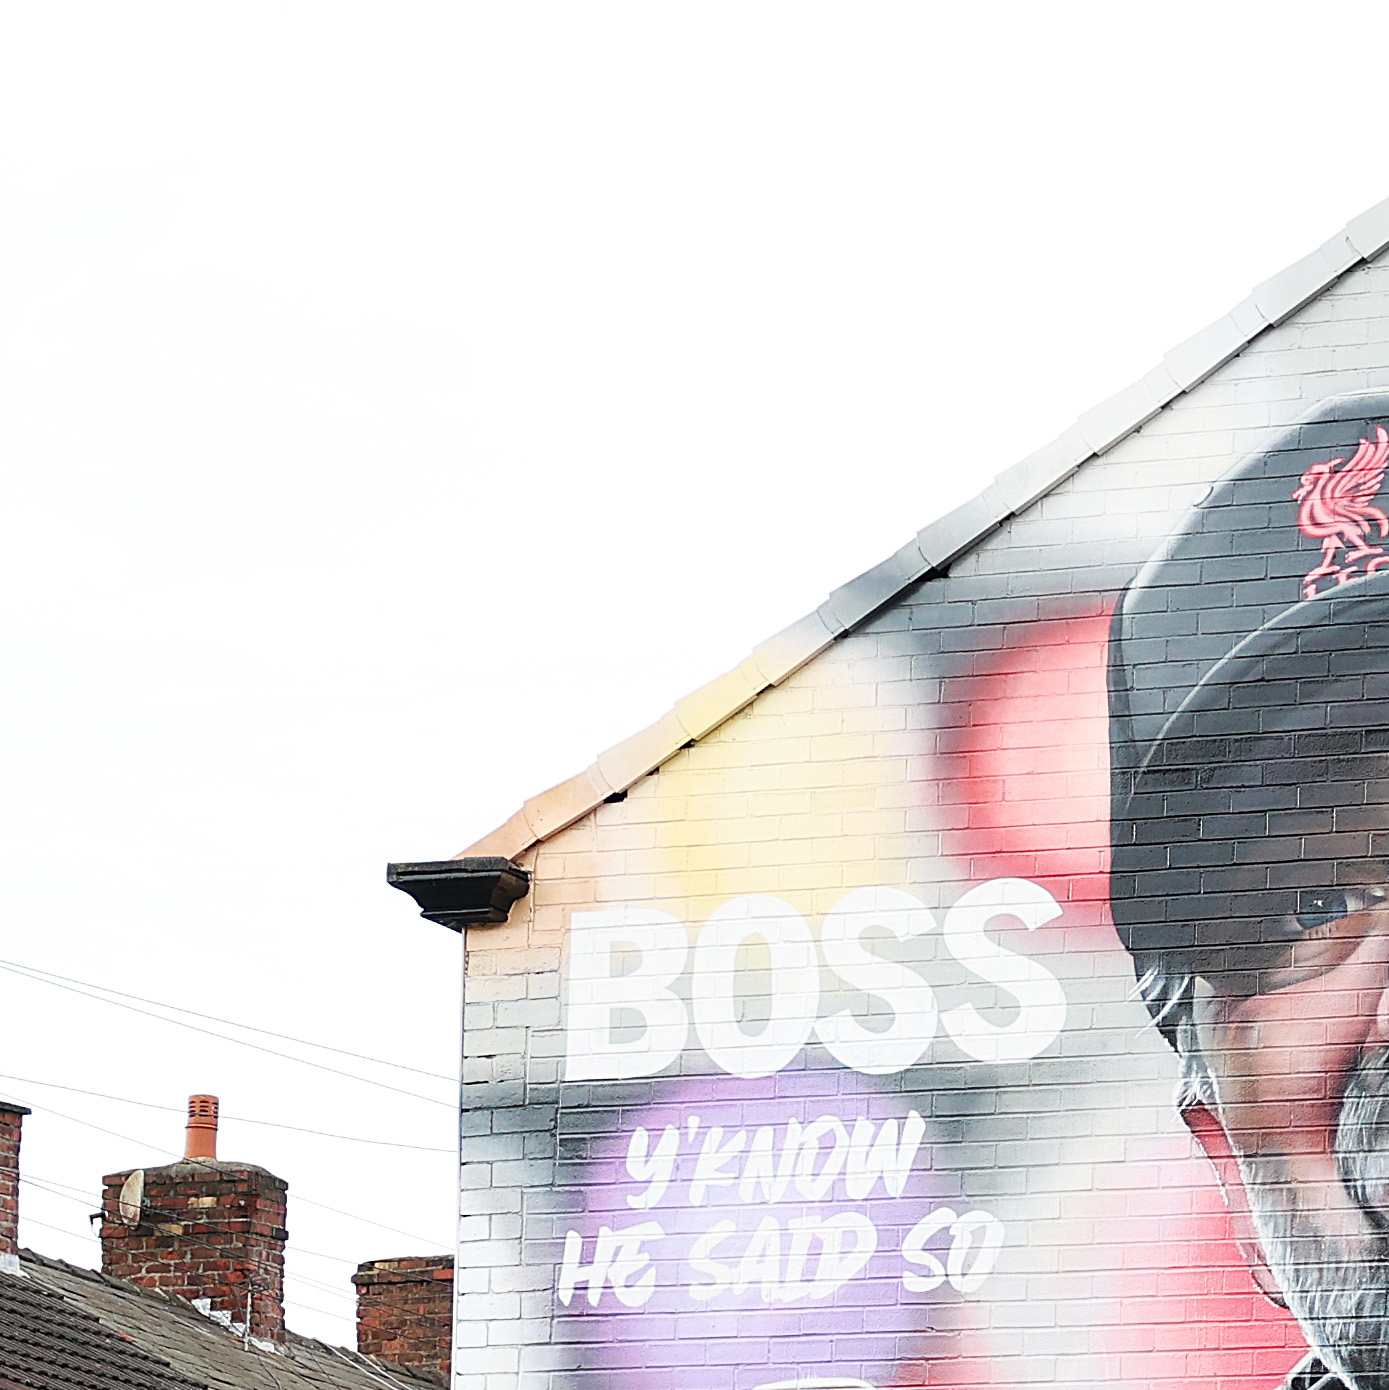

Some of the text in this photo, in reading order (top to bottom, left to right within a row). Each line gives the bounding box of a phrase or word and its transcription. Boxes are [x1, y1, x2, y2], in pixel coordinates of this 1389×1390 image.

[565, 877, 1067, 1081] BOSS
[625, 1110, 926, 1209] Y'KNOW
[557, 1206, 1005, 1306] HE SAID SO
